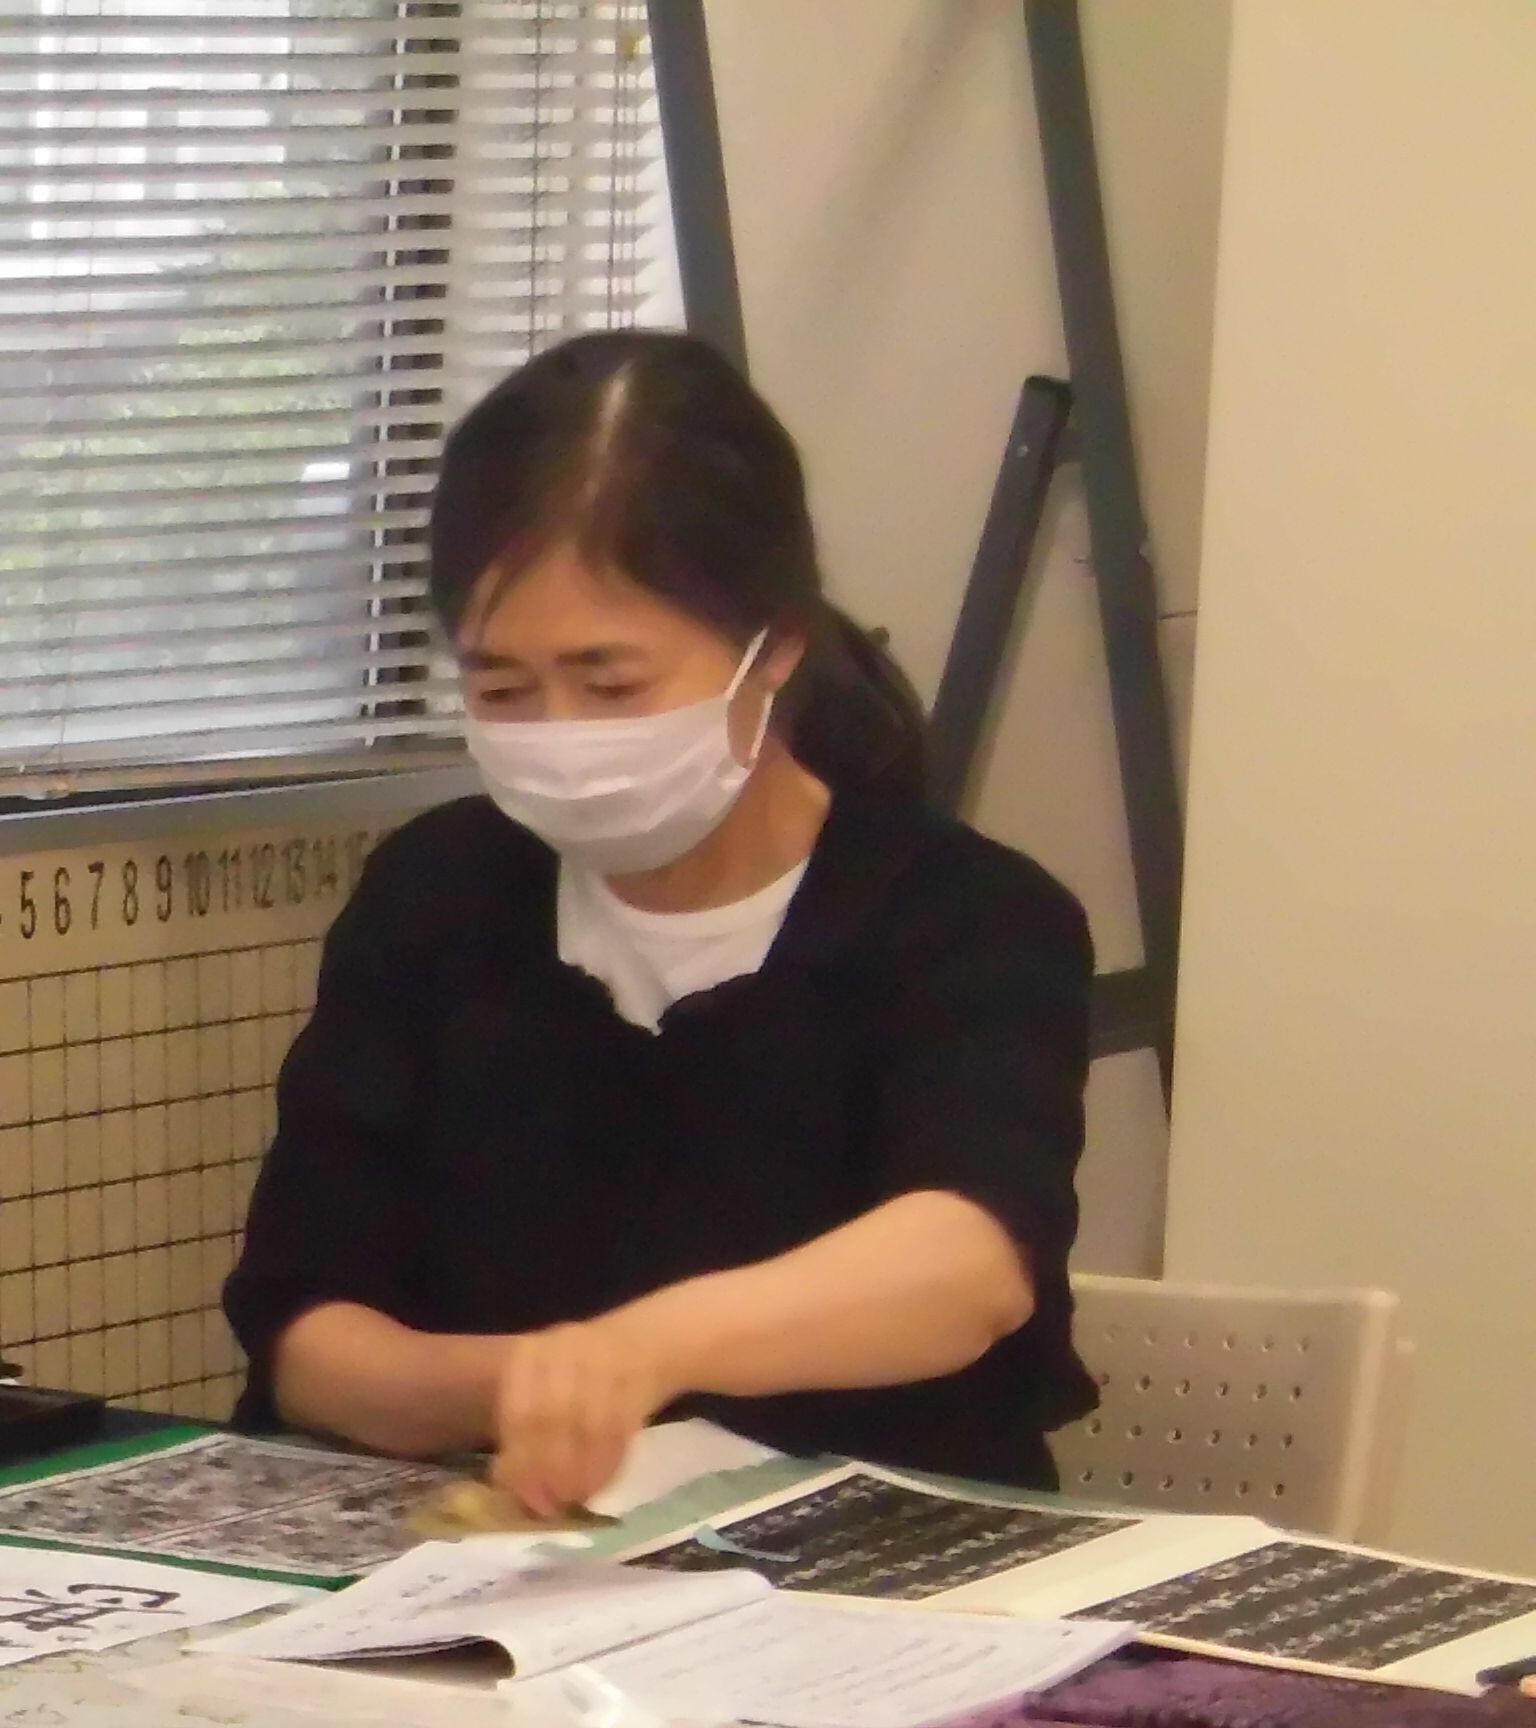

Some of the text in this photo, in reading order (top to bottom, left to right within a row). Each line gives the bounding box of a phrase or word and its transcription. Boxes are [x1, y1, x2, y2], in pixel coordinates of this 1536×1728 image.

[19, 871, 38, 939] 5
[54, 867, 73, 936] 6
[88, 861, 105, 930] 7
[122, 859, 140, 927] 8
[155, 855, 173, 922] 9
[184, 850, 210, 917] 10
[217, 846, 242, 913] 11
[249, 842, 275, 910] 12
[281, 838, 307, 905] 13
[312, 834, 338, 901] 14
